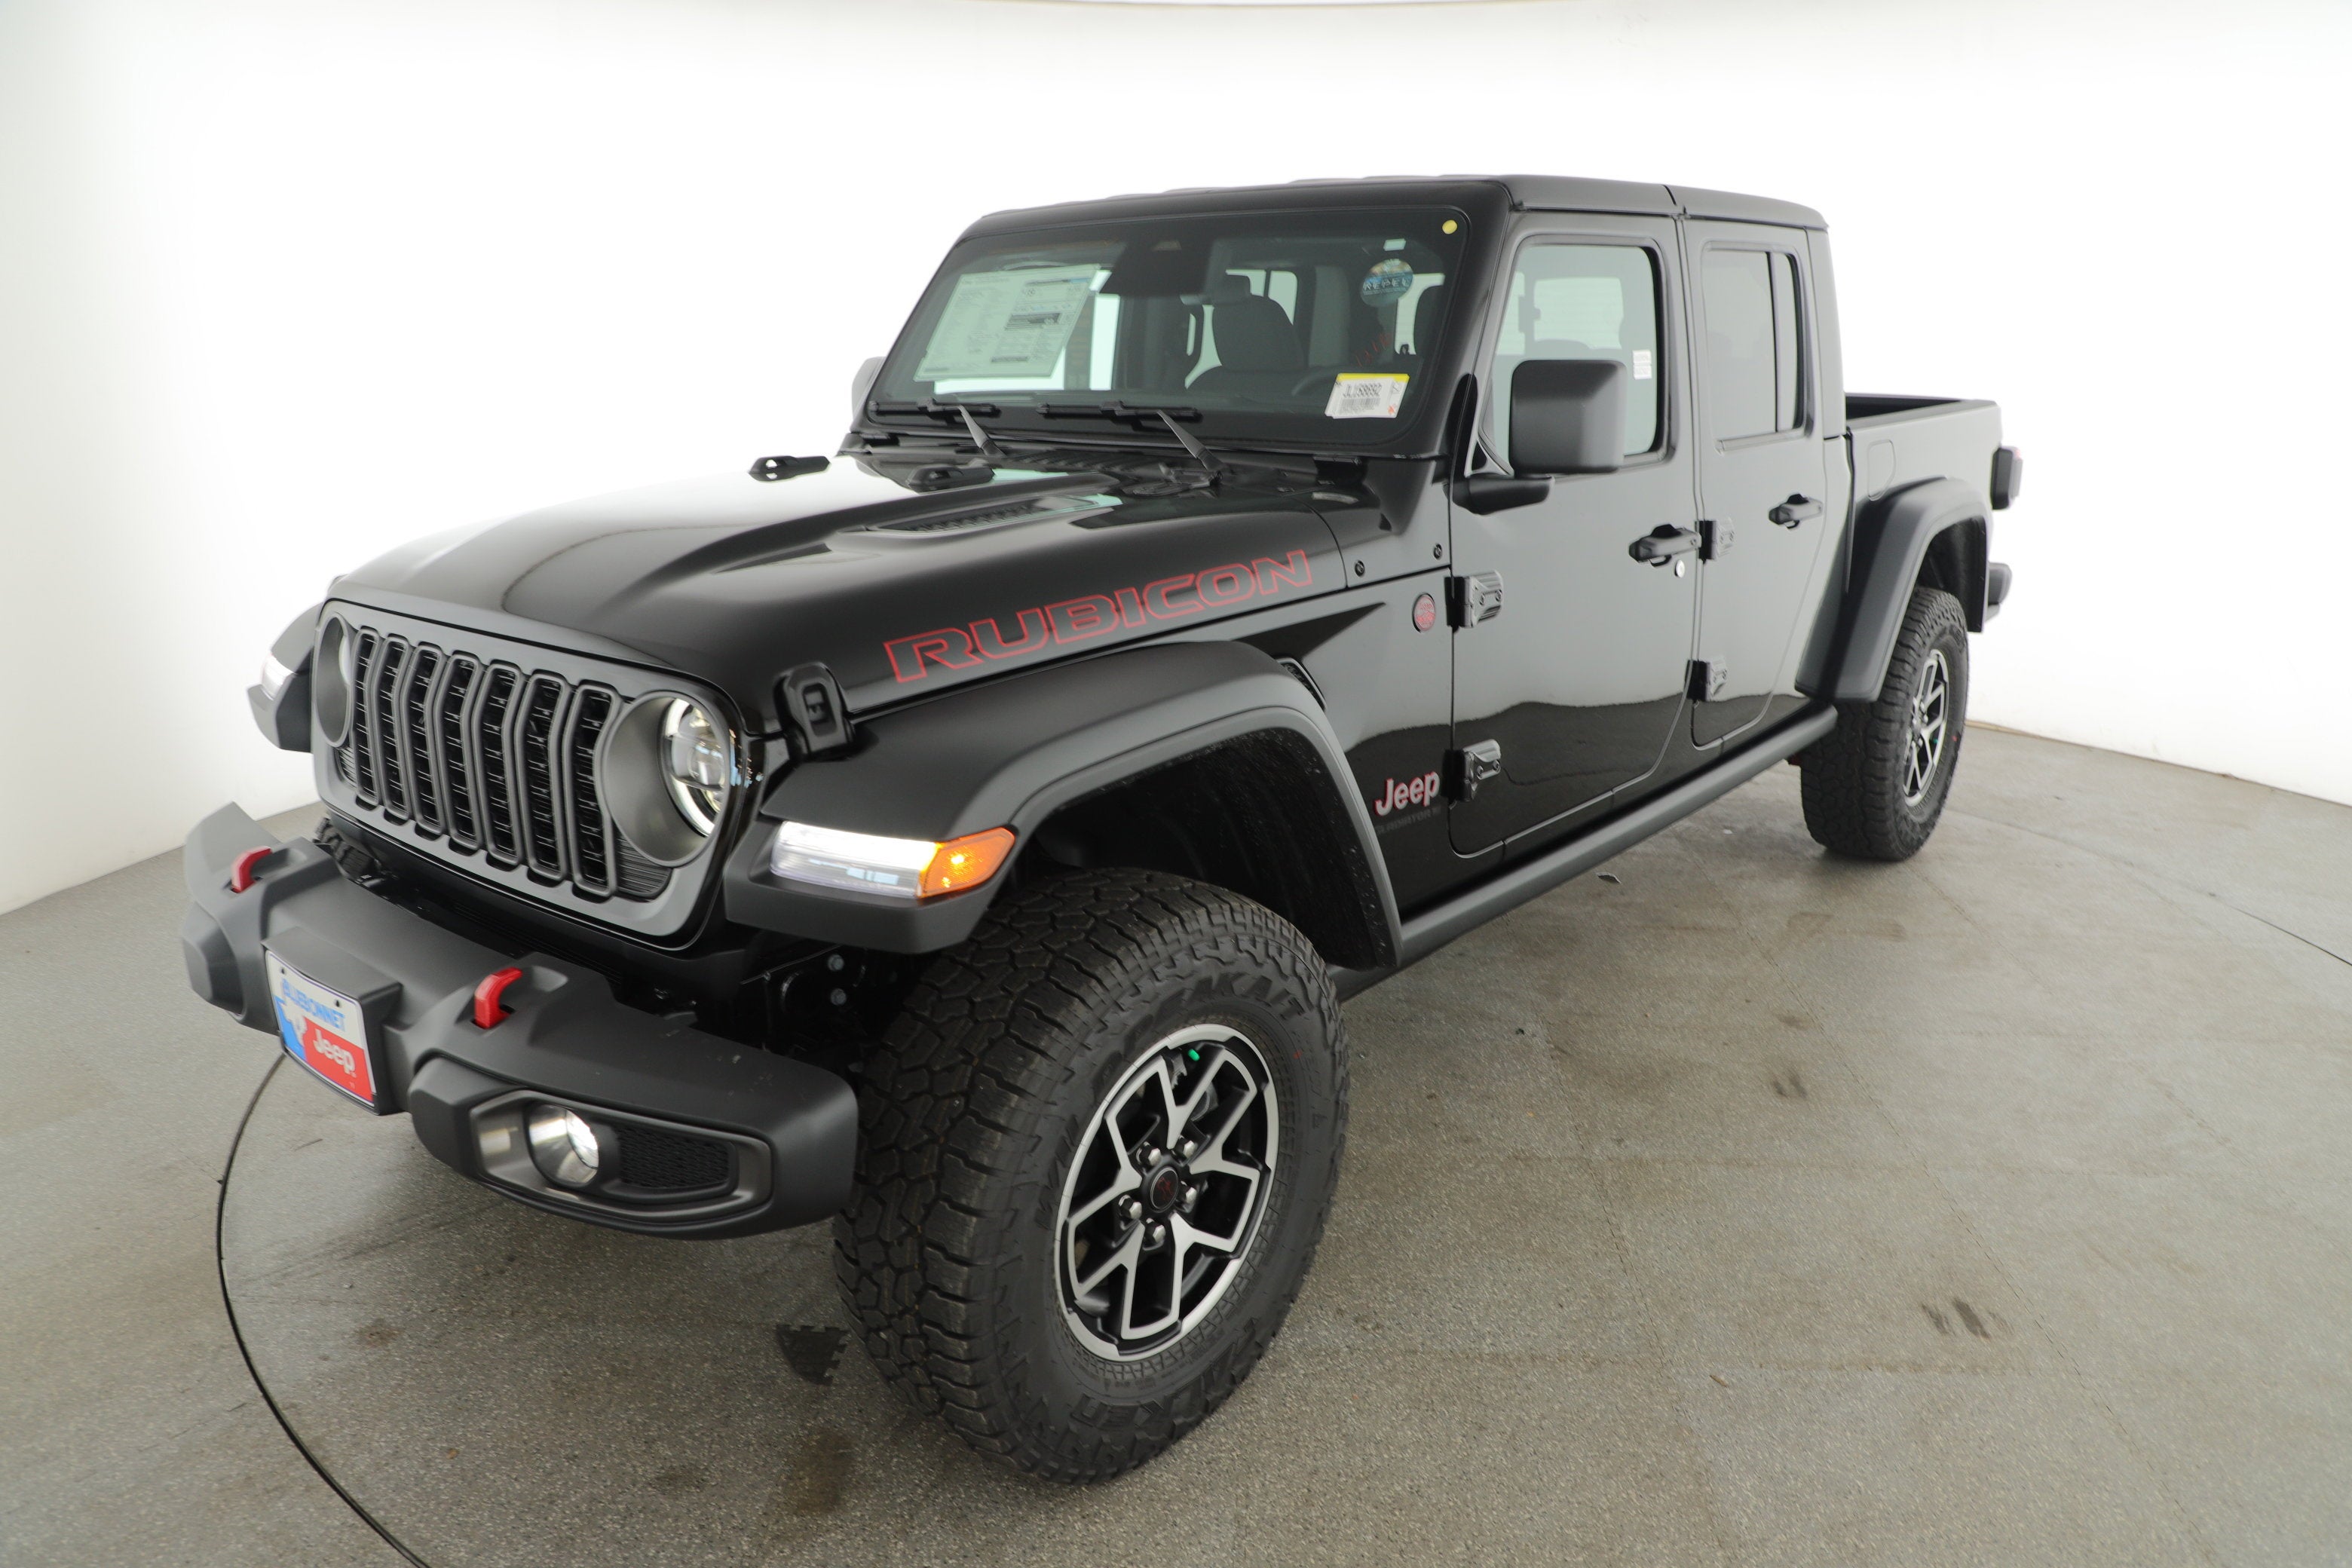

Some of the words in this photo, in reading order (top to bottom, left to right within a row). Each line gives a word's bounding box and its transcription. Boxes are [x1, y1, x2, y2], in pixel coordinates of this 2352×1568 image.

[884, 550, 1313, 683] RUBICON
[1374, 770, 1440, 816] Jeep
[282, 978, 346, 1031] BLUEBONNET
[313, 1028, 355, 1074] Jeep
[1070, 1316, 1257, 1432] FALKEN
